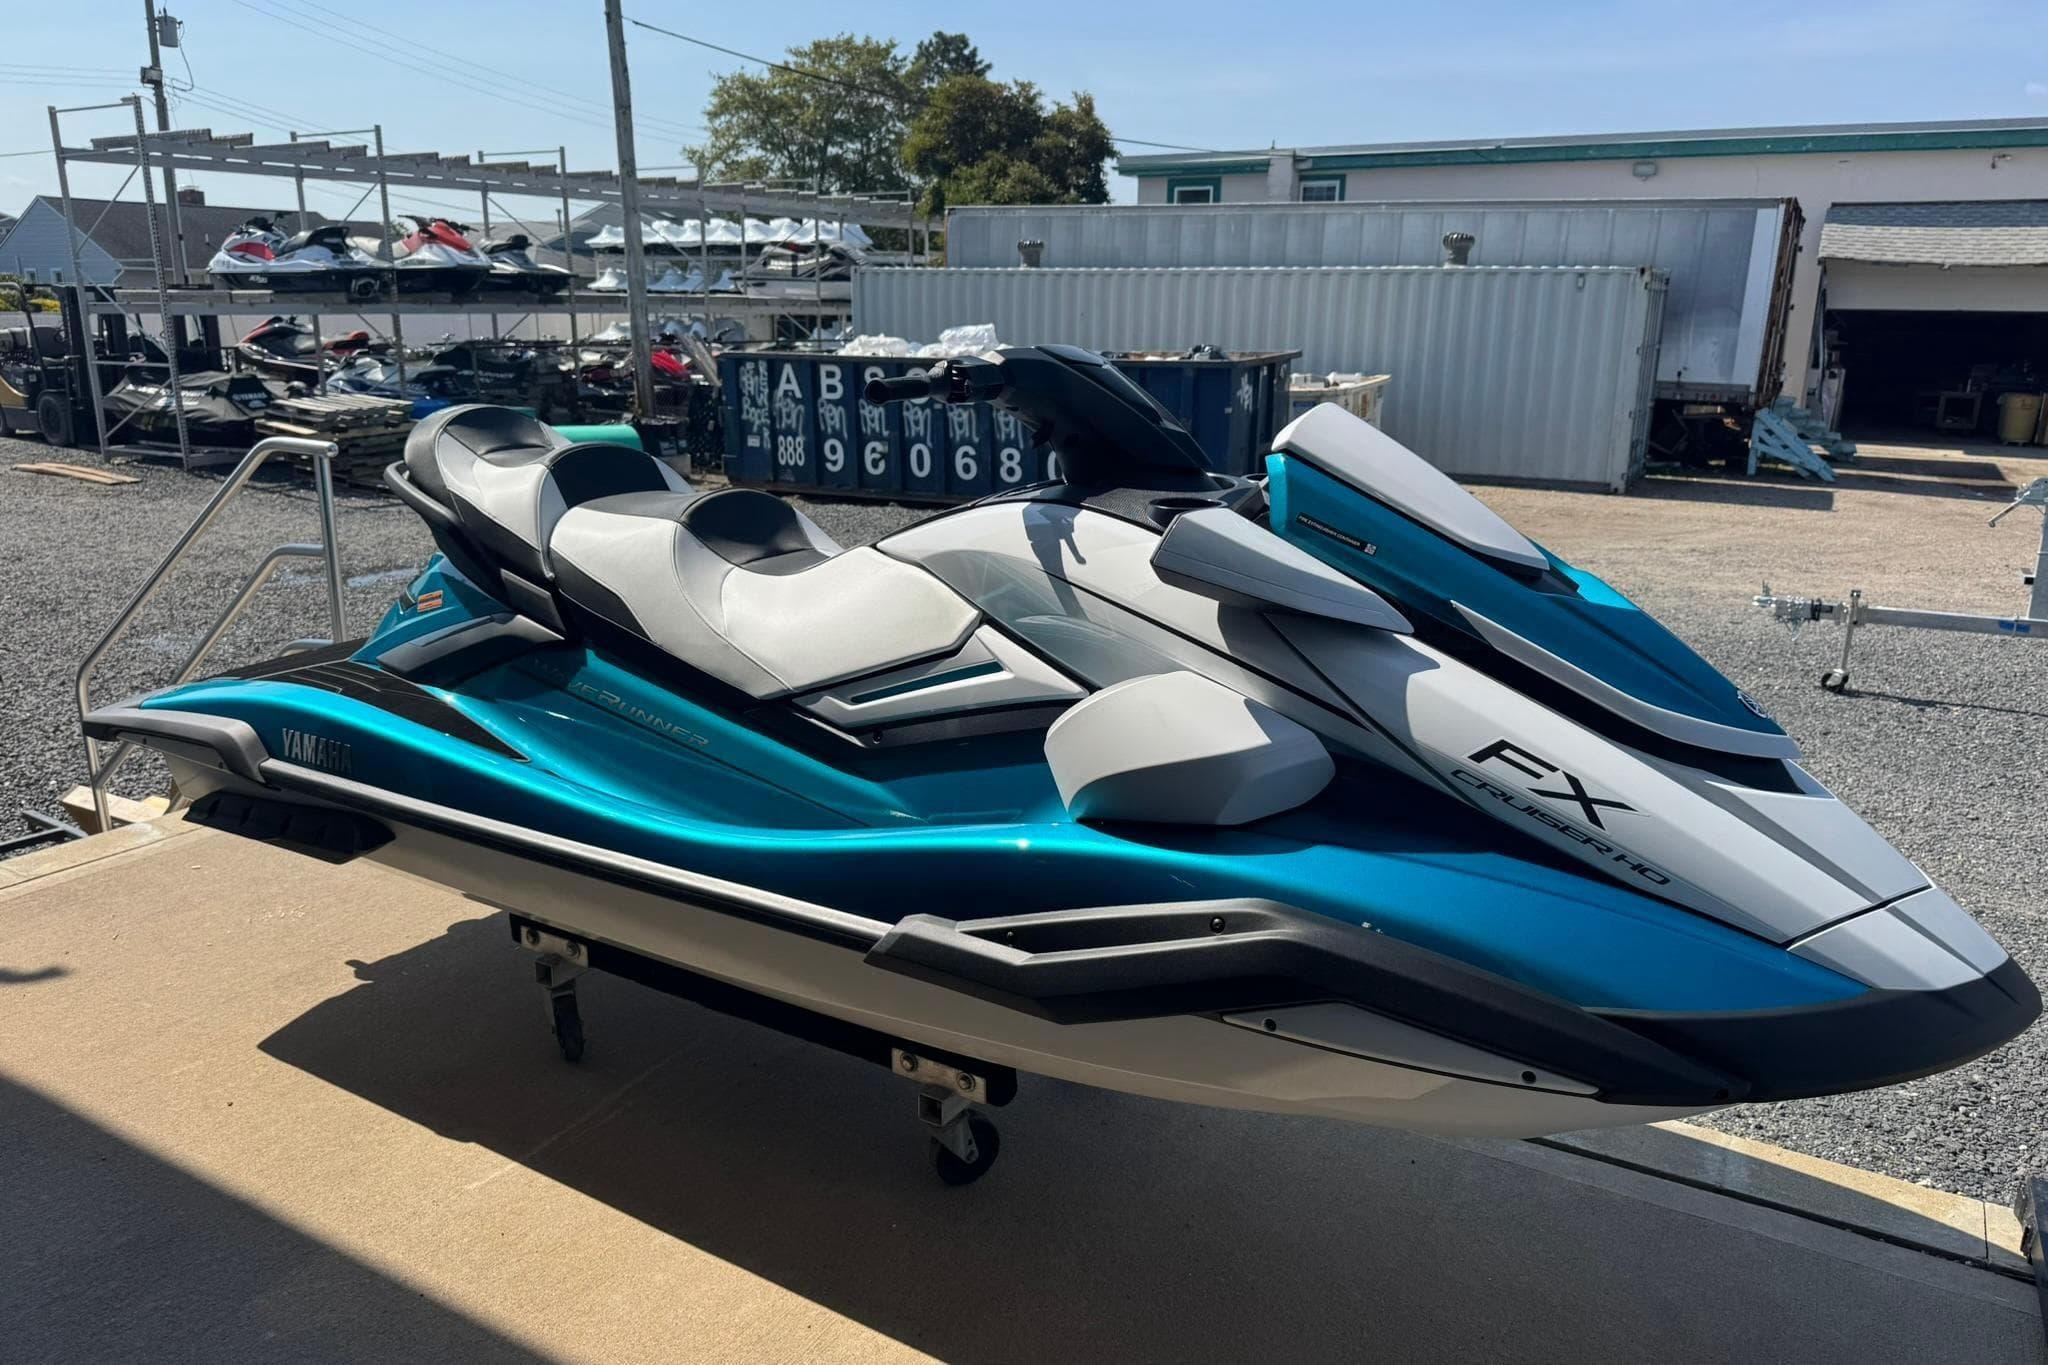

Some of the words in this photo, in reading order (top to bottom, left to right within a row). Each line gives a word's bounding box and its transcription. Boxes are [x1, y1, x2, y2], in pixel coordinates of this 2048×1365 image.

[777, 435, 805, 467] 888
[281, 727, 352, 774] YAMAHA
[1467, 738, 1639, 831] FX
[1450, 768, 1614, 856] CRUISER
[1613, 853, 1672, 887] HO
